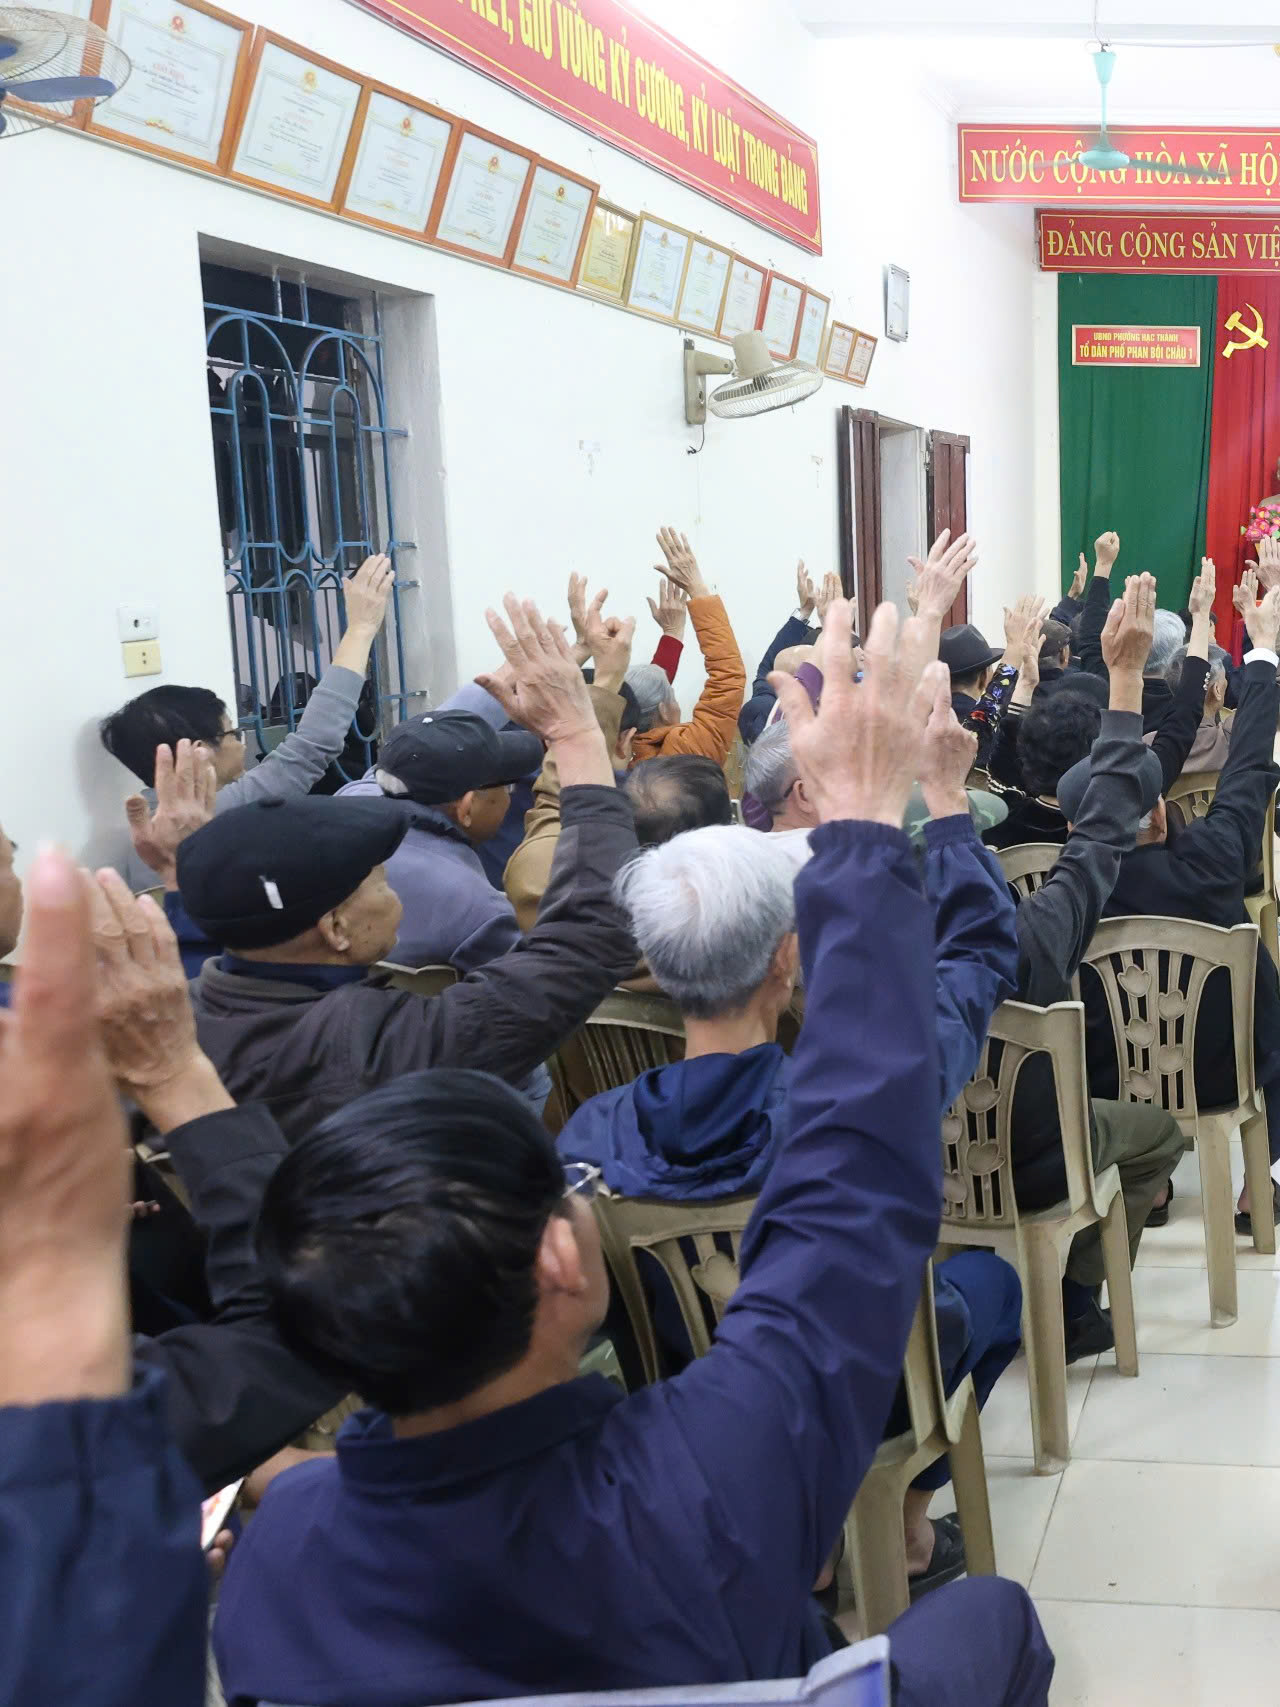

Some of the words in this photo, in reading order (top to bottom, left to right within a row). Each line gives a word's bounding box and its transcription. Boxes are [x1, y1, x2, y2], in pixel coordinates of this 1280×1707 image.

[609, 25, 630, 108] KỶ
[691, 82, 708, 156] KỶ
[711, 107, 741, 184] LUẬT
[743, 128, 779, 198] TRONG
[780, 143, 809, 216] ĐẢNG
[970, 139, 1046, 184] NƯỚC
[1135, 142, 1192, 185] HÒA
[1196, 143, 1233, 186] XÃ
[1047, 219, 1113, 258] ĐẢNG
[1119, 223, 1186, 265] CỘNG
[1192, 221, 1238, 260] SẢN
[1080, 341, 1090, 357] TỔ
[1091, 343, 1107, 358] DÂN
[1109, 342, 1126, 358] PHỐ
[1127, 346, 1149, 359] PHAN
[1151, 344, 1163, 361] BỘI
[1165, 344, 1186, 359] CHÂU
[1188, 348, 1193, 359] 1
